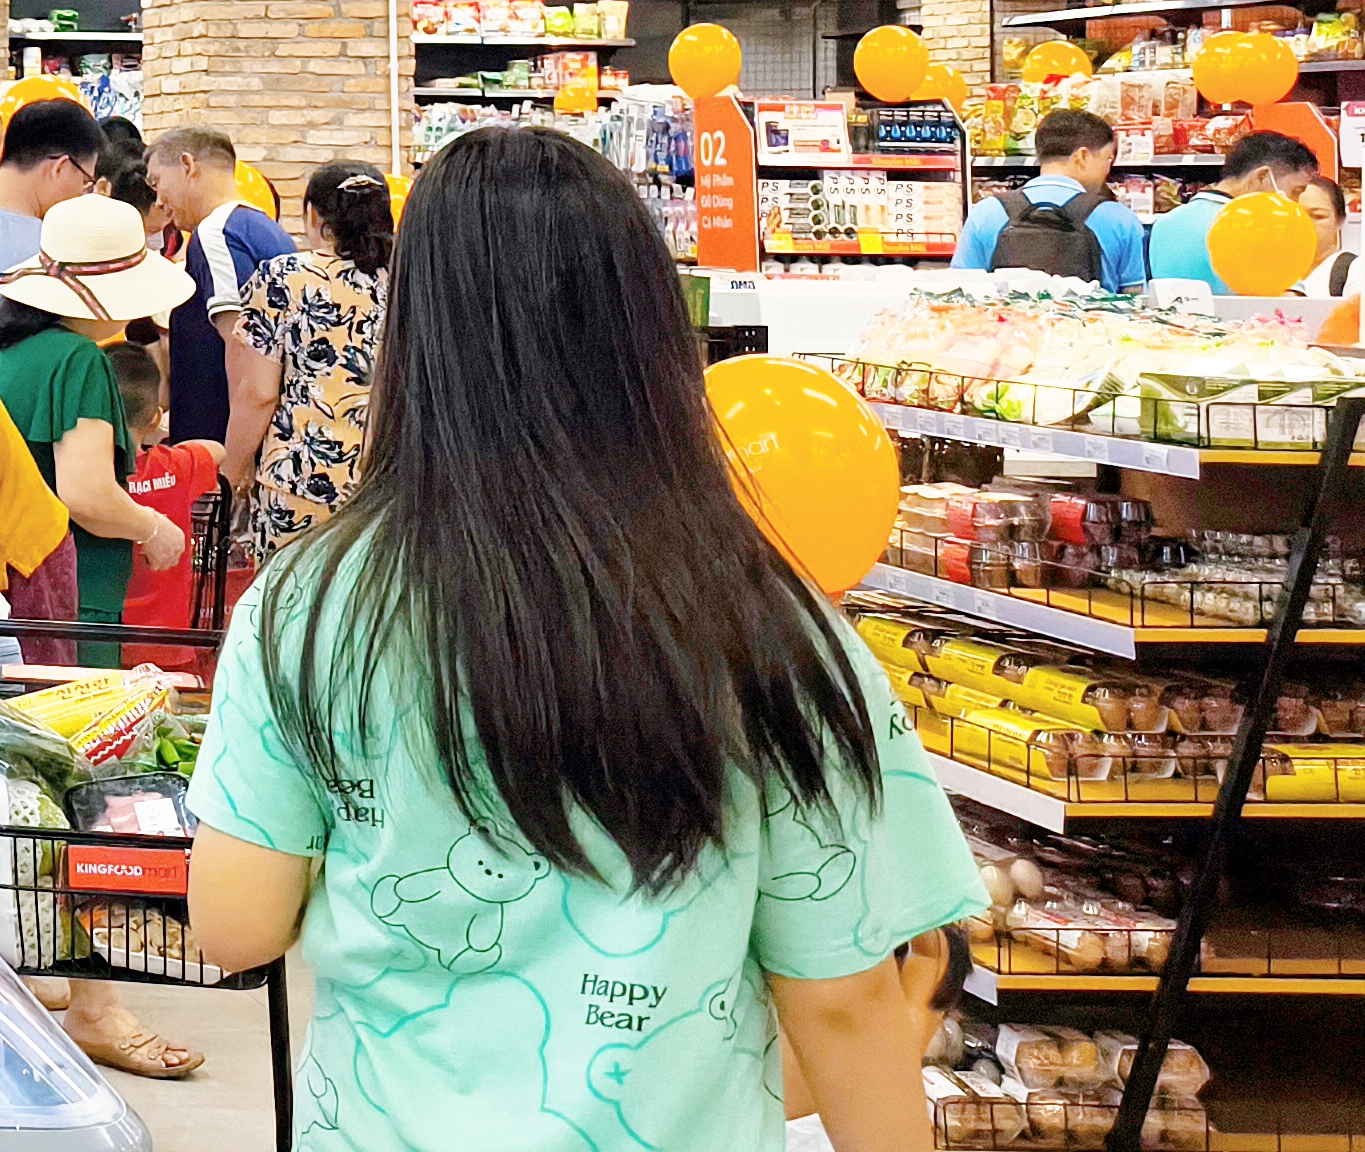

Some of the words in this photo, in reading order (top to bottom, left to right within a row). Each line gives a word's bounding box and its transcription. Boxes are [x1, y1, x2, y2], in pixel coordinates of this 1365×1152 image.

[700, 130, 727, 166] 02
[761, 181, 779, 191] PS
[895, 183, 914, 193] PS
[895, 199, 914, 208] PS
[895, 213, 914, 223] PS
[580, 973, 668, 1008] Happy
[585, 1004, 651, 1031] Bear
